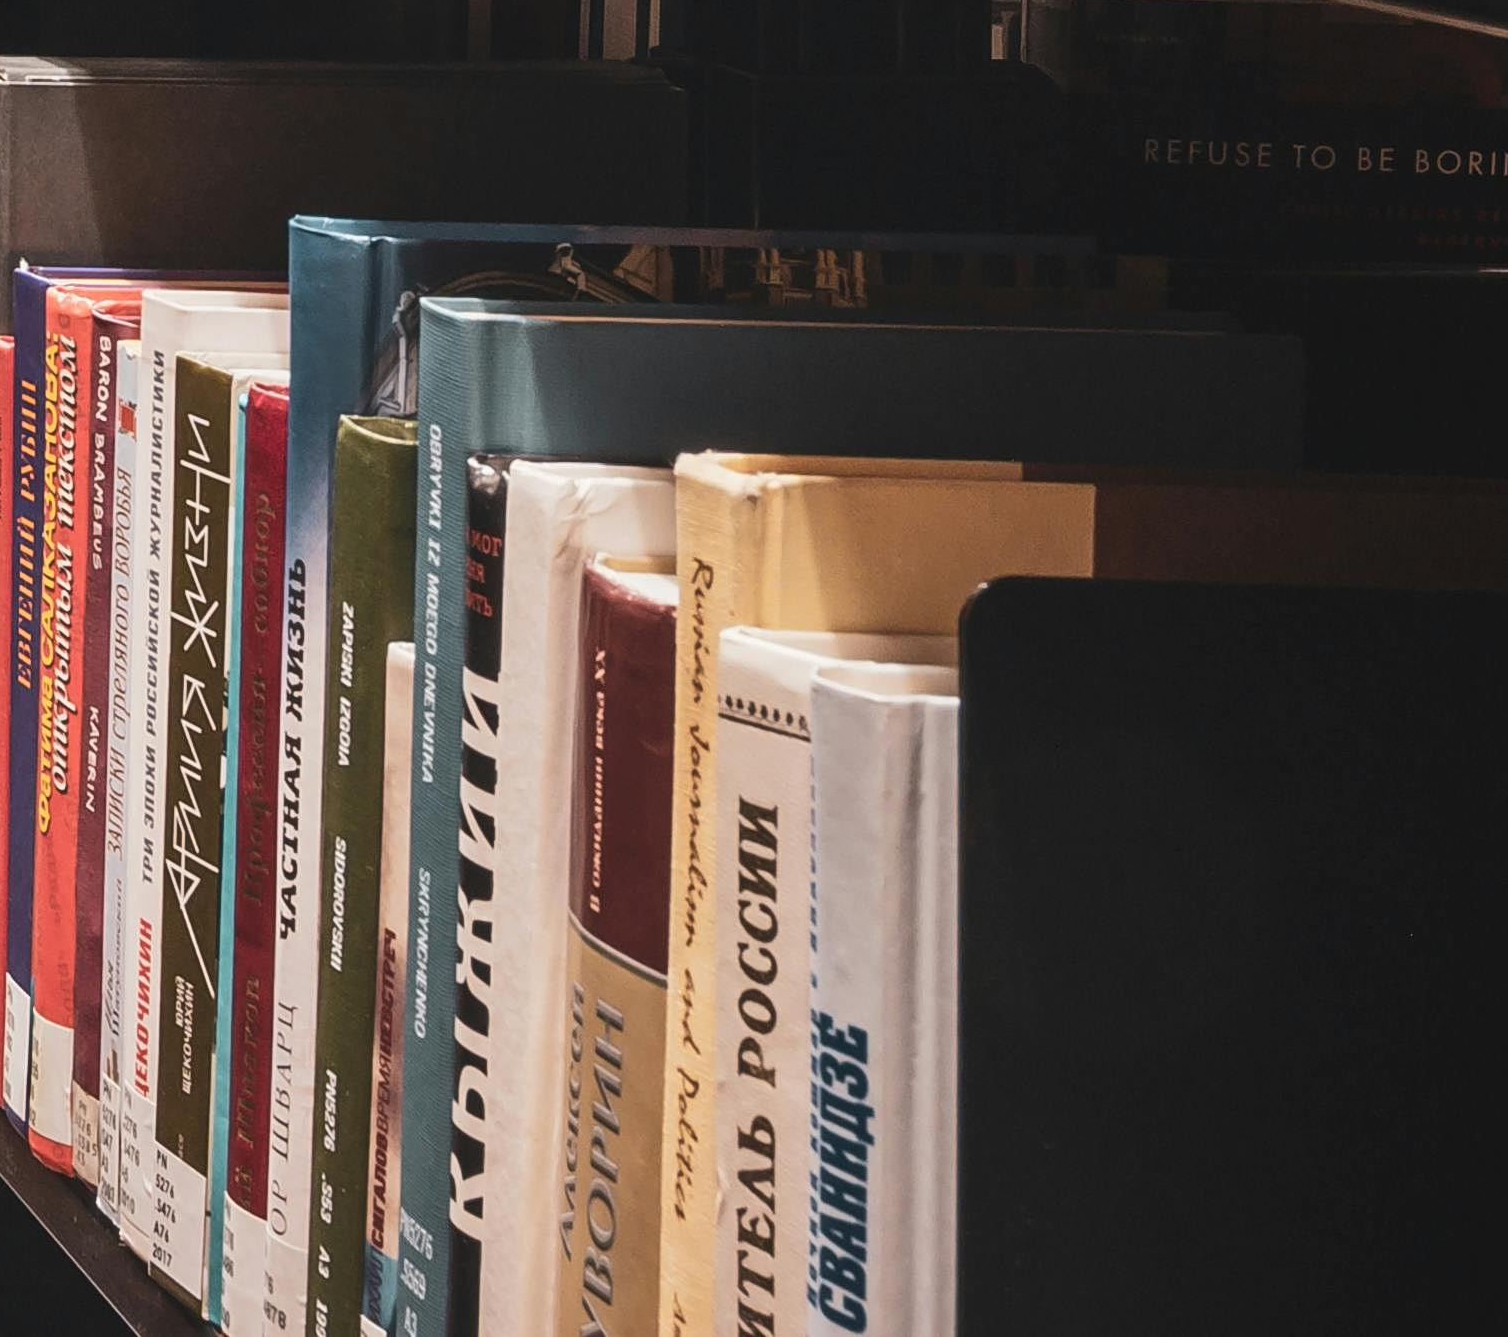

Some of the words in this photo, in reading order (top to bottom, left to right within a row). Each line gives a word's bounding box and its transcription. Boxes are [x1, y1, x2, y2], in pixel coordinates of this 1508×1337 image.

[1144, 137, 1274, 168] REFUSE
[1293, 143, 1337, 171] TO
[1357, 146, 1397, 173] BE
[20, 378, 39, 502] РУБИН
[58, 335, 77, 533] текстом
[94, 334, 113, 423] BARON
[91, 431, 108, 572] BRAMBEUS
[150, 349, 166, 561] ЖУРНАЛИСТИКИ
[426, 423, 444, 534] OBRYVKI
[17, 515, 35, 691] ЕВГЕНИЙ
[424, 570, 441, 657] MOEGO
[426, 535, 442, 564] IZ
[51, 540, 77, 794] открытым
[146, 571, 162, 738] РОССИЙСКОЙ
[285, 557, 307, 724] ЖИЗНЬ
[339, 602, 357, 688] ZAPISKI
[690, 557, 715, 725] Russian
[84, 704, 100, 813] KAVERIN
[143, 741, 158, 826] ЭПОХИ
[337, 690, 353, 767] IZGOIA
[421, 658, 439, 784] DNEVNIKA
[142, 830, 155, 885] ТРИ
[278, 731, 303, 942] ЧАСТНАЯ
[330, 836, 348, 972] SIDOROVSKII
[684, 722, 712, 950] Journalism
[414, 866, 432, 1040] SKRYNCHENKO
[735, 793, 780, 1090] РОССИИ
[682, 966, 700, 1057] and
[324, 1068, 338, 1153] PN5276
[675, 1065, 702, 1224] Politics
[816, 1011, 877, 1336] СВАНИДЗЕ
